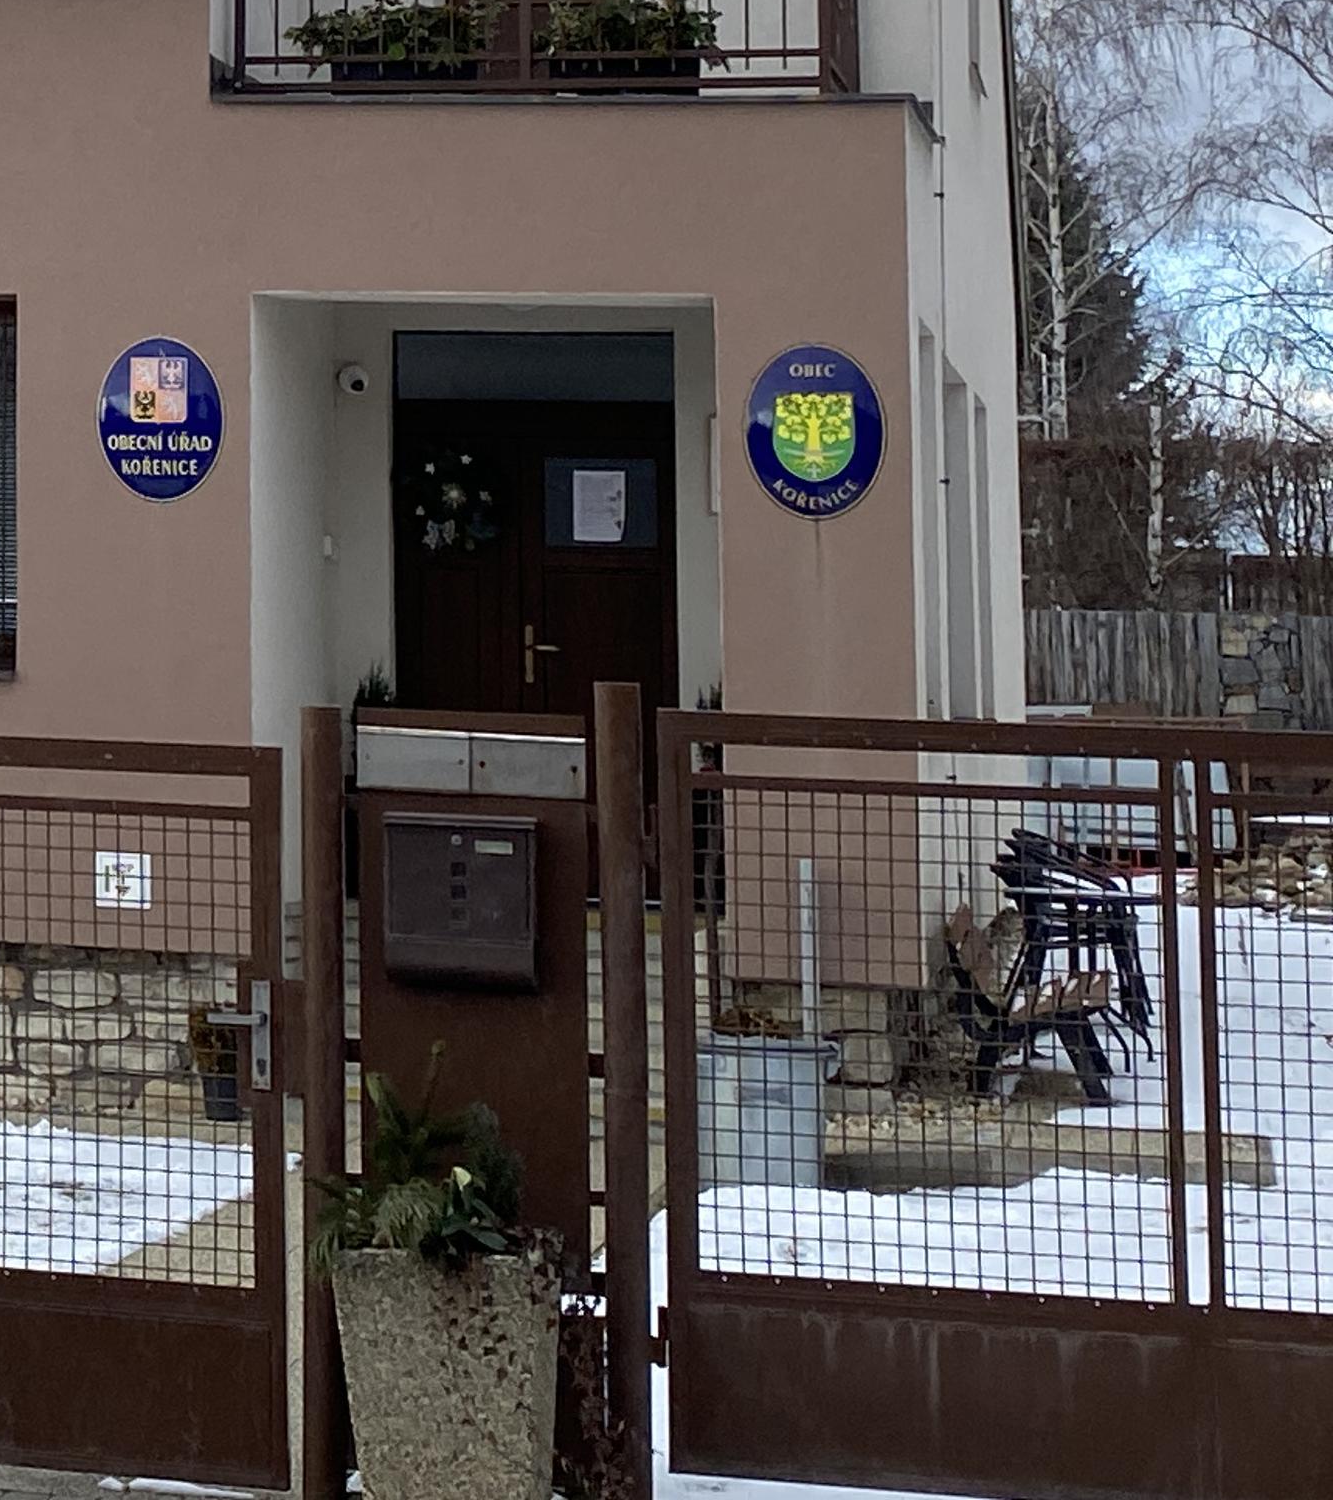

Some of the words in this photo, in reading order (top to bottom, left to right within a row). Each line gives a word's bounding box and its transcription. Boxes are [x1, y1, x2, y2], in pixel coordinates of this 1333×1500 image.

[789, 363, 836, 378] OBEC
[107, 430, 163, 451] OBECNÍ
[168, 430, 213, 452] ÚŘAD
[121, 455, 198, 476] KOŘENICE
[773, 478, 860, 510] KOŘENICE
